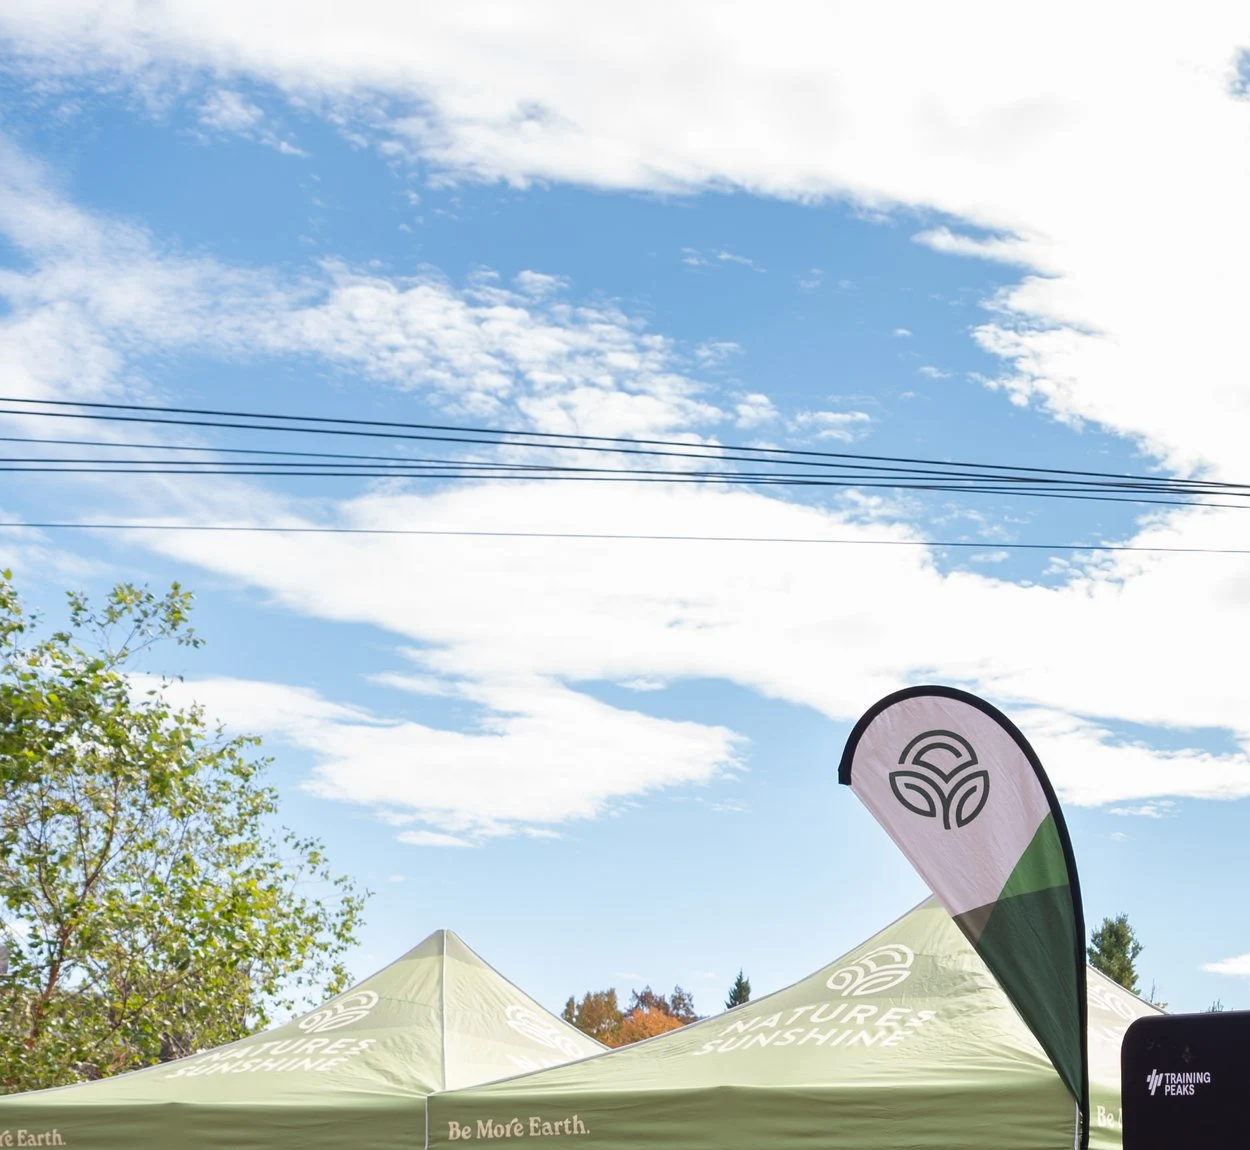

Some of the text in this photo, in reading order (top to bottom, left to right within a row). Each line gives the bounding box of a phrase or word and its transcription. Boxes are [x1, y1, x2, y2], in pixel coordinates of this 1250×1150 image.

[725, 1004, 937, 1036] NATURES
[196, 1038, 376, 1063] NATURES
[692, 1023, 918, 1056] SUNSHINE
[165, 1058, 351, 1080] SUNSHINE
[1164, 1072, 1211, 1086] TRAINING
[1164, 1083, 1195, 1096] PEAKS
[448, 1114, 591, 1141] Be More Earth.
[1097, 1106, 1115, 1127] Be
[17, 1128, 67, 1147] Earth.
